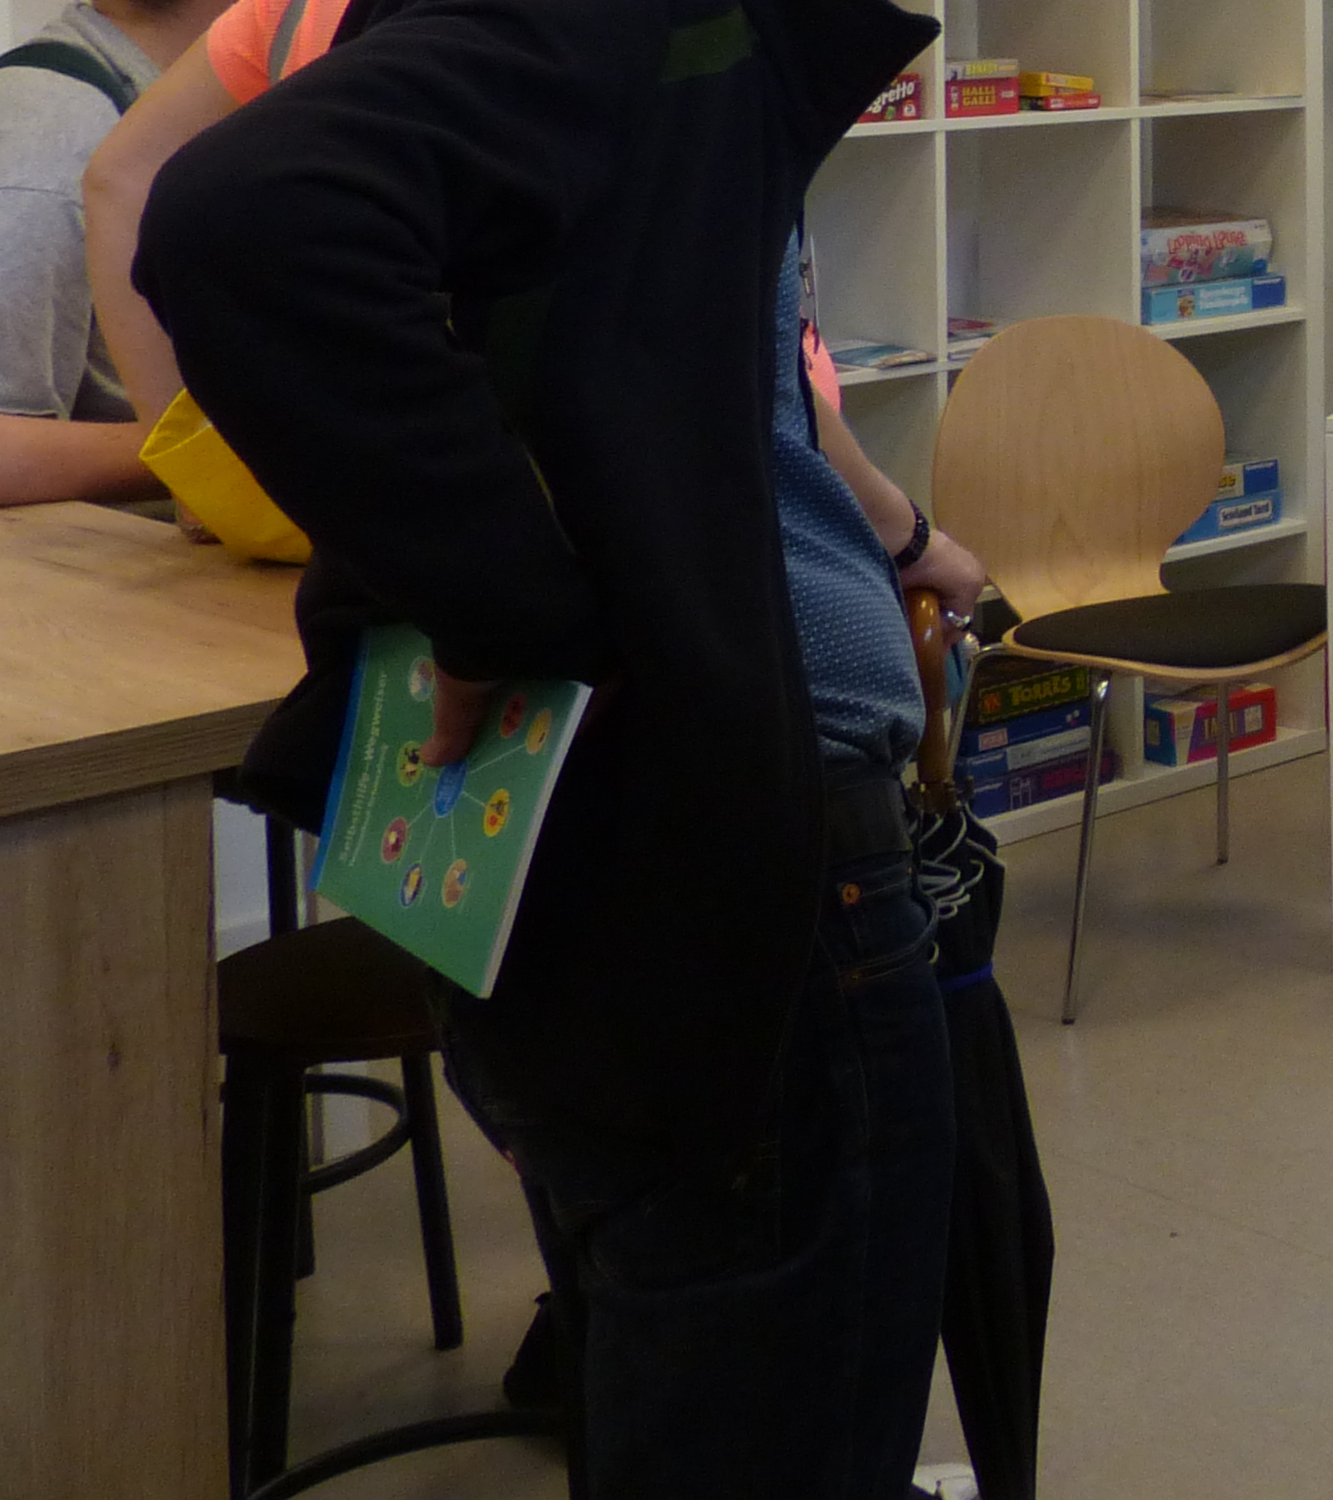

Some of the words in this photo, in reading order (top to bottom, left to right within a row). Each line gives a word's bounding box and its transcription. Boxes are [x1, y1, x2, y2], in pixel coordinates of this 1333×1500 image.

[866, 80, 916, 114] gretto
[962, 86, 996, 97] HALLI
[962, 95, 997, 106] GALLI
[1009, 674, 1072, 706] TORRES
